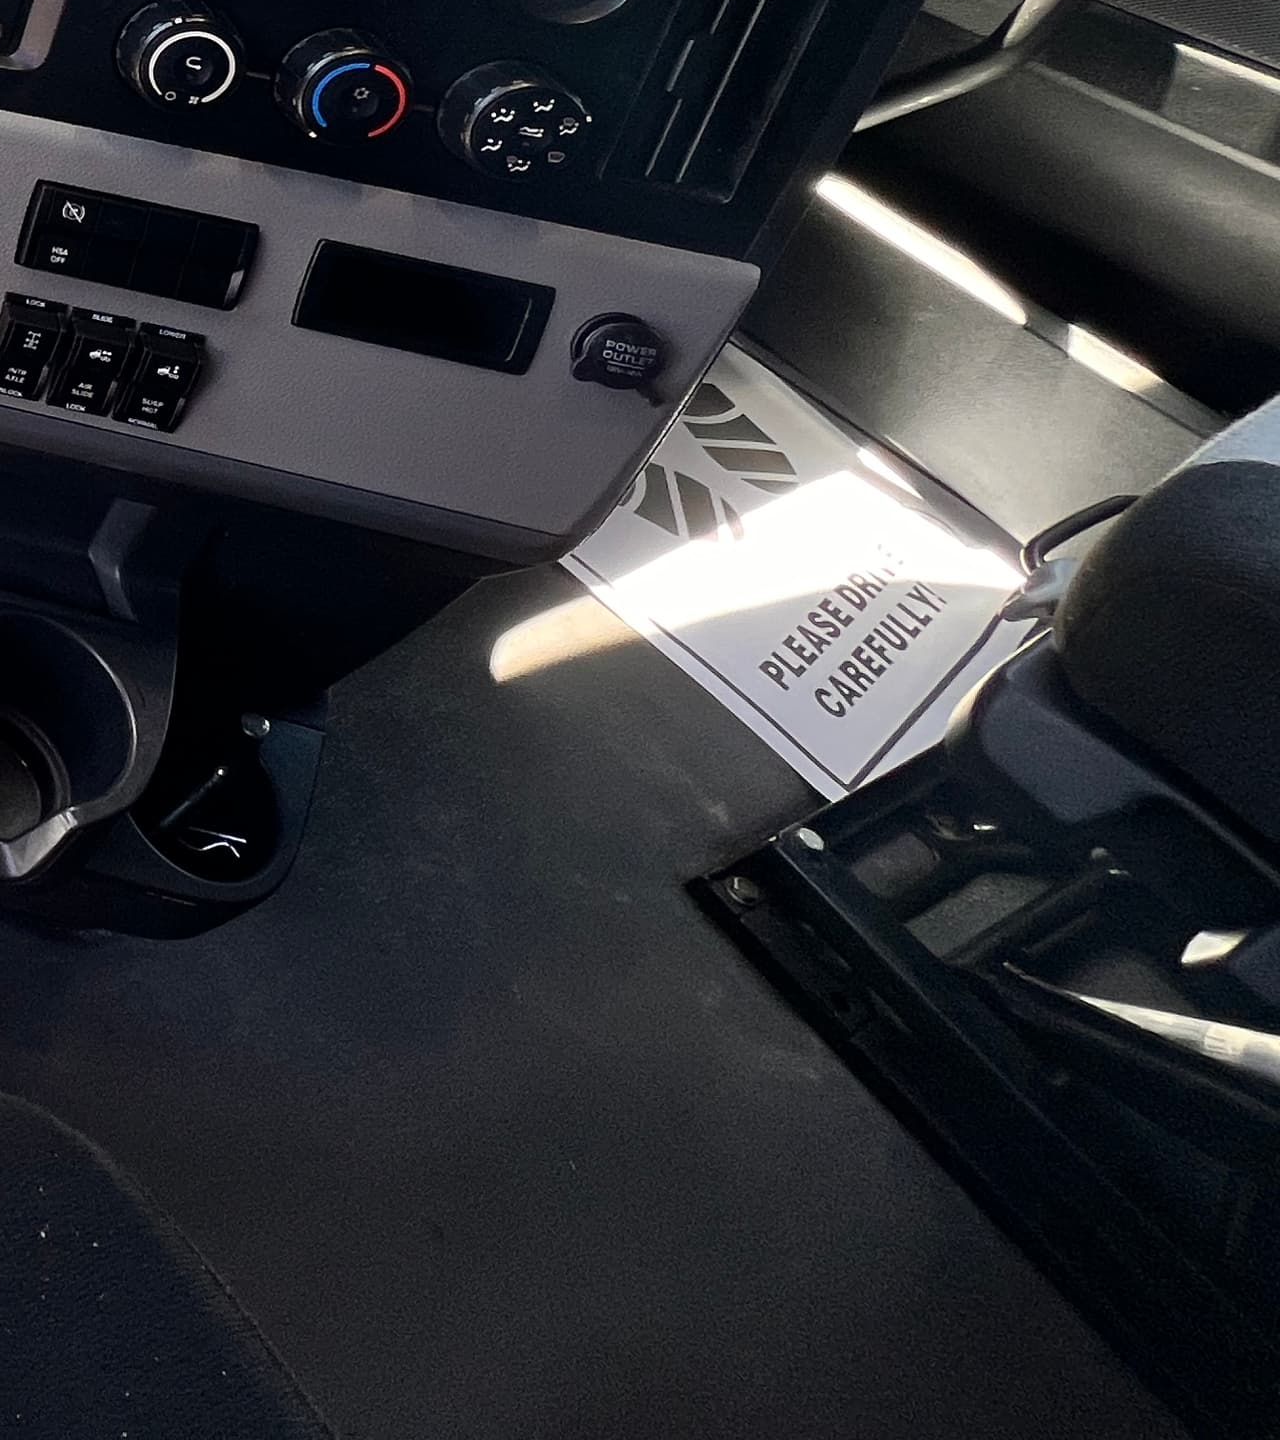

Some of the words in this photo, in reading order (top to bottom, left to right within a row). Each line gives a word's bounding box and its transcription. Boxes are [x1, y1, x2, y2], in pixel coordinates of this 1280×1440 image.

[50, 255, 66, 264] OFF
[26, 298, 46, 308] LOCK
[606, 340, 657, 356] POWER
[602, 350, 655, 366] OUTLET
[66, 403, 86, 412] LOCK
[758, 598, 855, 691] PLEASE
[815, 581, 947, 718] CAREFULLY!
